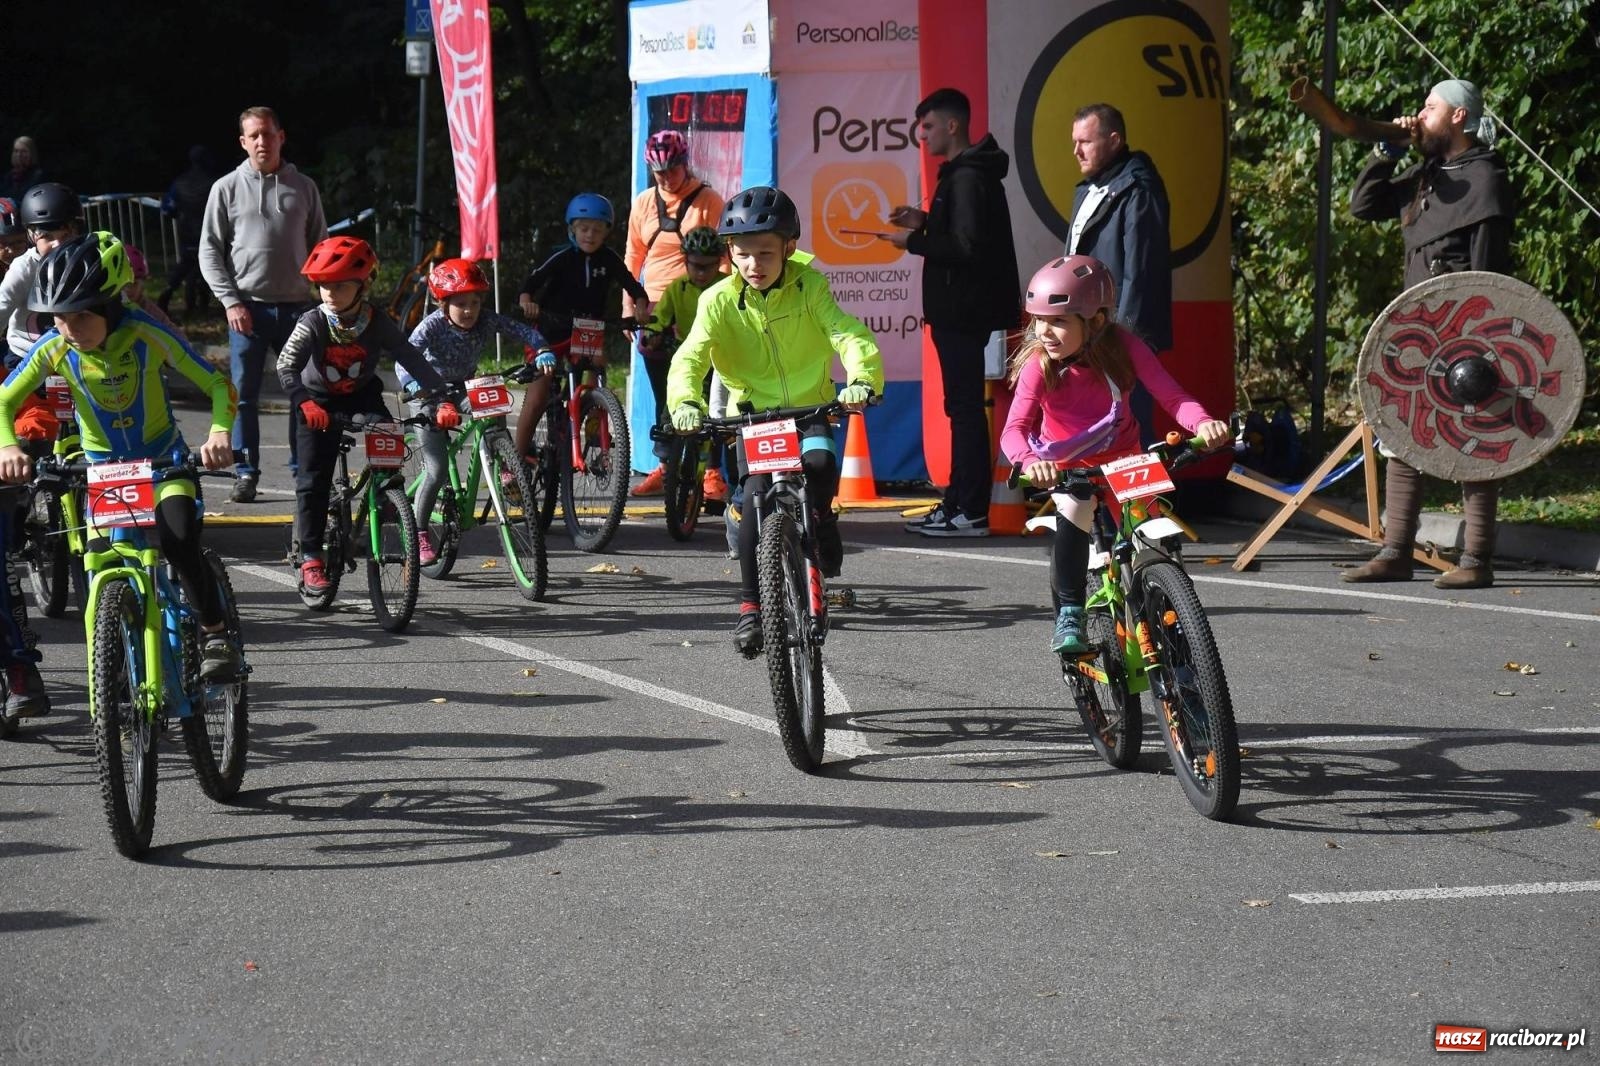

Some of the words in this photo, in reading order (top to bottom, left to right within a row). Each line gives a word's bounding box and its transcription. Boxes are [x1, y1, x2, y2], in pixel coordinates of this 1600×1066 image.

[868, 287, 909, 302] CZASU
[478, 389, 500, 404] 83
[374, 438, 397, 451] 93
[758, 438, 788, 455] 82
[1122, 467, 1150, 485] 77
[103, 485, 140, 505] 96
